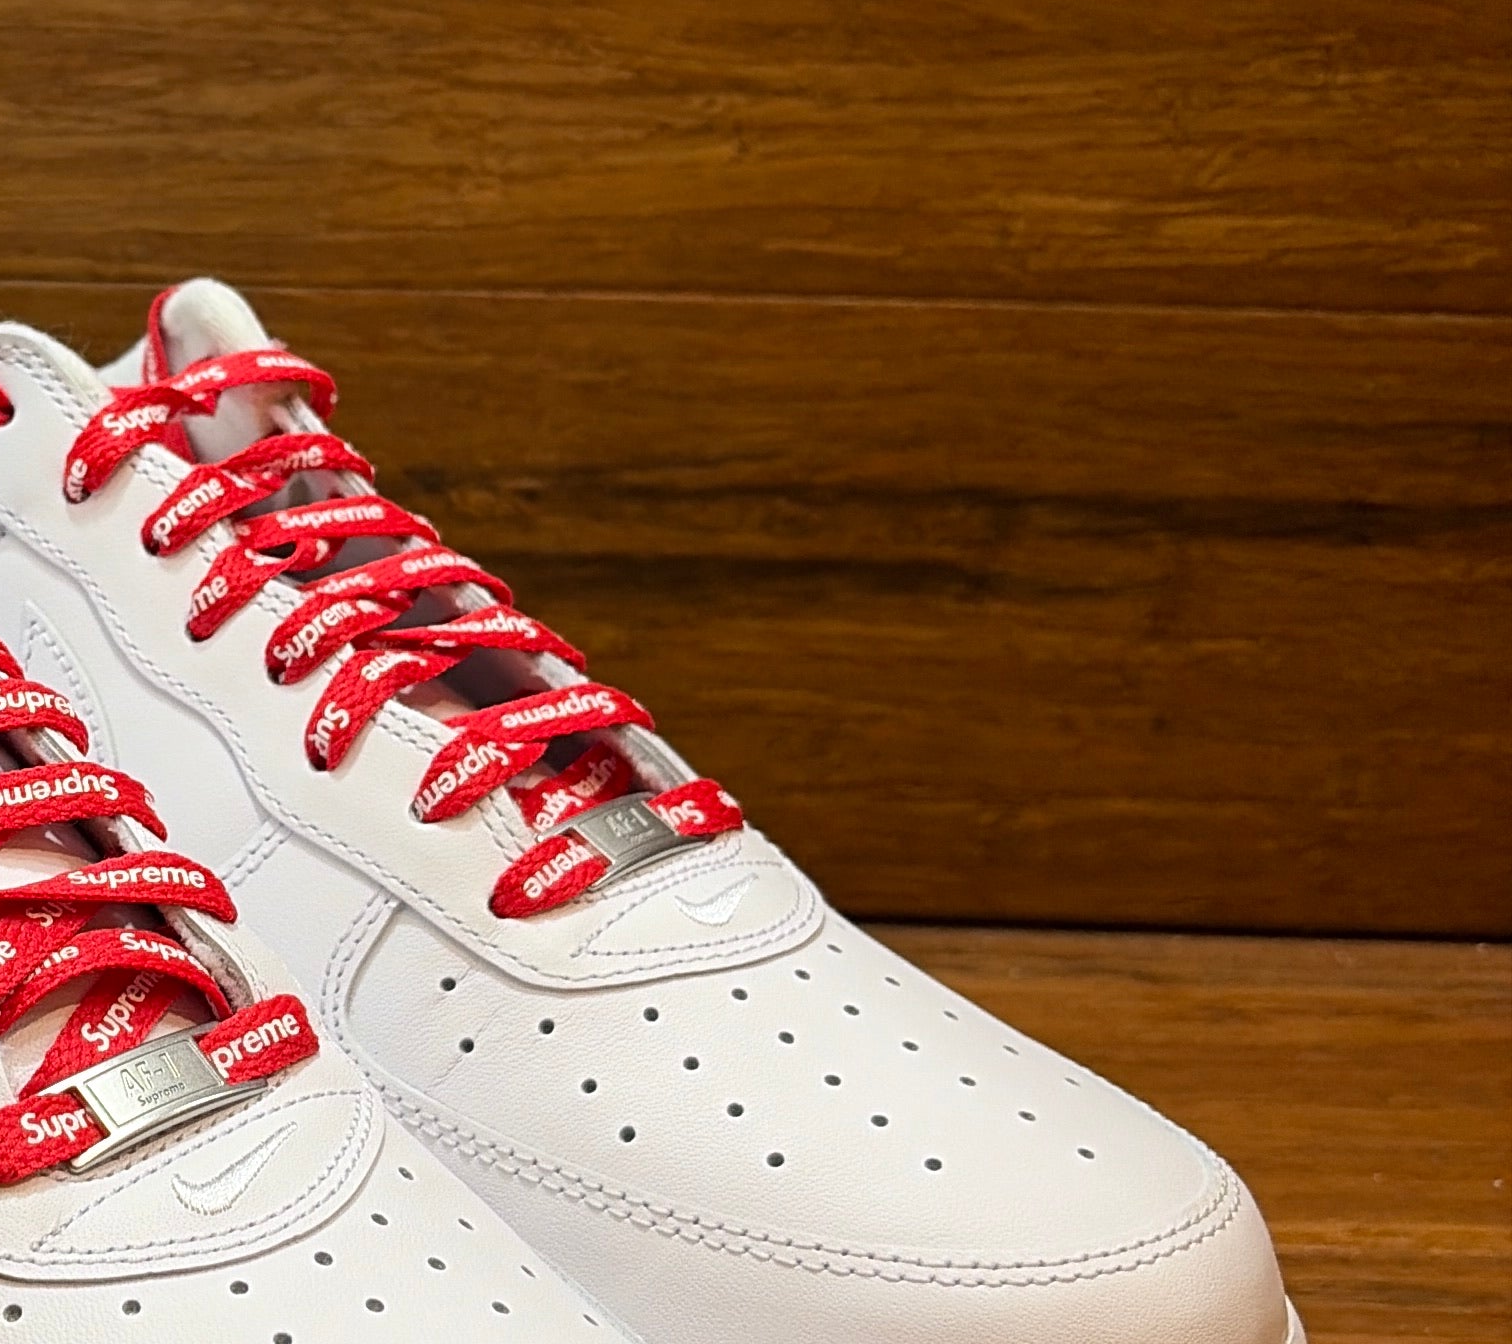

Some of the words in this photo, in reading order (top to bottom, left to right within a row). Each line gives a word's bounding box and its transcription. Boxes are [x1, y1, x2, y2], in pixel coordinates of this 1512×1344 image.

[275, 505, 385, 530] Supreme
[500, 690, 617, 729] Supreme
[67, 866, 206, 889] Supreme
[19, 1108, 94, 1145] Supr
